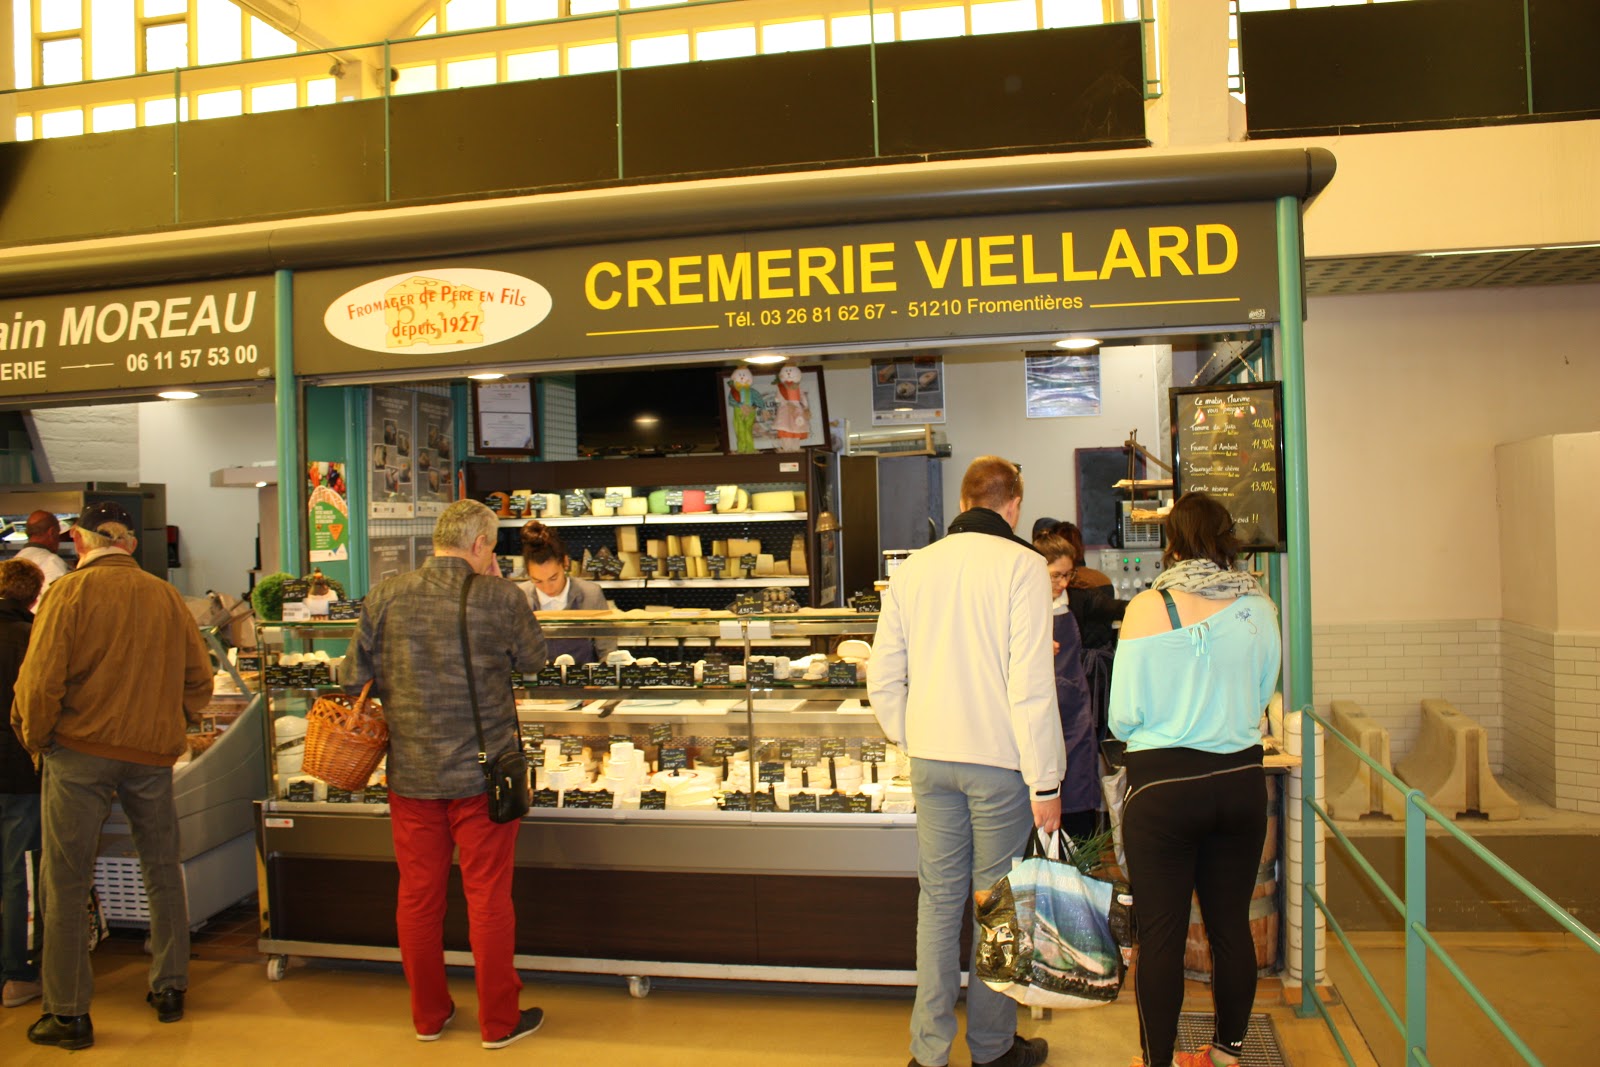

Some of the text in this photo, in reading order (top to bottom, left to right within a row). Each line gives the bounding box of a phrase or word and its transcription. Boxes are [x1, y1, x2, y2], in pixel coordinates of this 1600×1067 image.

[584, 223, 1239, 311] CREMERIE VIELLARD
[58, 291, 256, 346] MOREAU
[347, 294, 415, 319] FROMAGER
[419, 286, 436, 304] de
[479, 290, 494, 303] EN
[500, 287, 527, 307] Fils
[725, 311, 755, 327] Tél.
[760, 310, 782, 326] 03
[786, 308, 808, 324] 26
[812, 307, 832, 323] 81
[838, 305, 860, 321] 62
[864, 303, 886, 319] 67
[908, 299, 962, 318] 51210
[967, 294, 1083, 315] Fromentières
[392, 315, 479, 340] depuis 1927
[126, 353, 149, 373] 06
[154, 351, 173, 371] 11
[180, 349, 202, 369] 57
[207, 347, 230, 367] 53
[235, 344, 258, 364] 00
